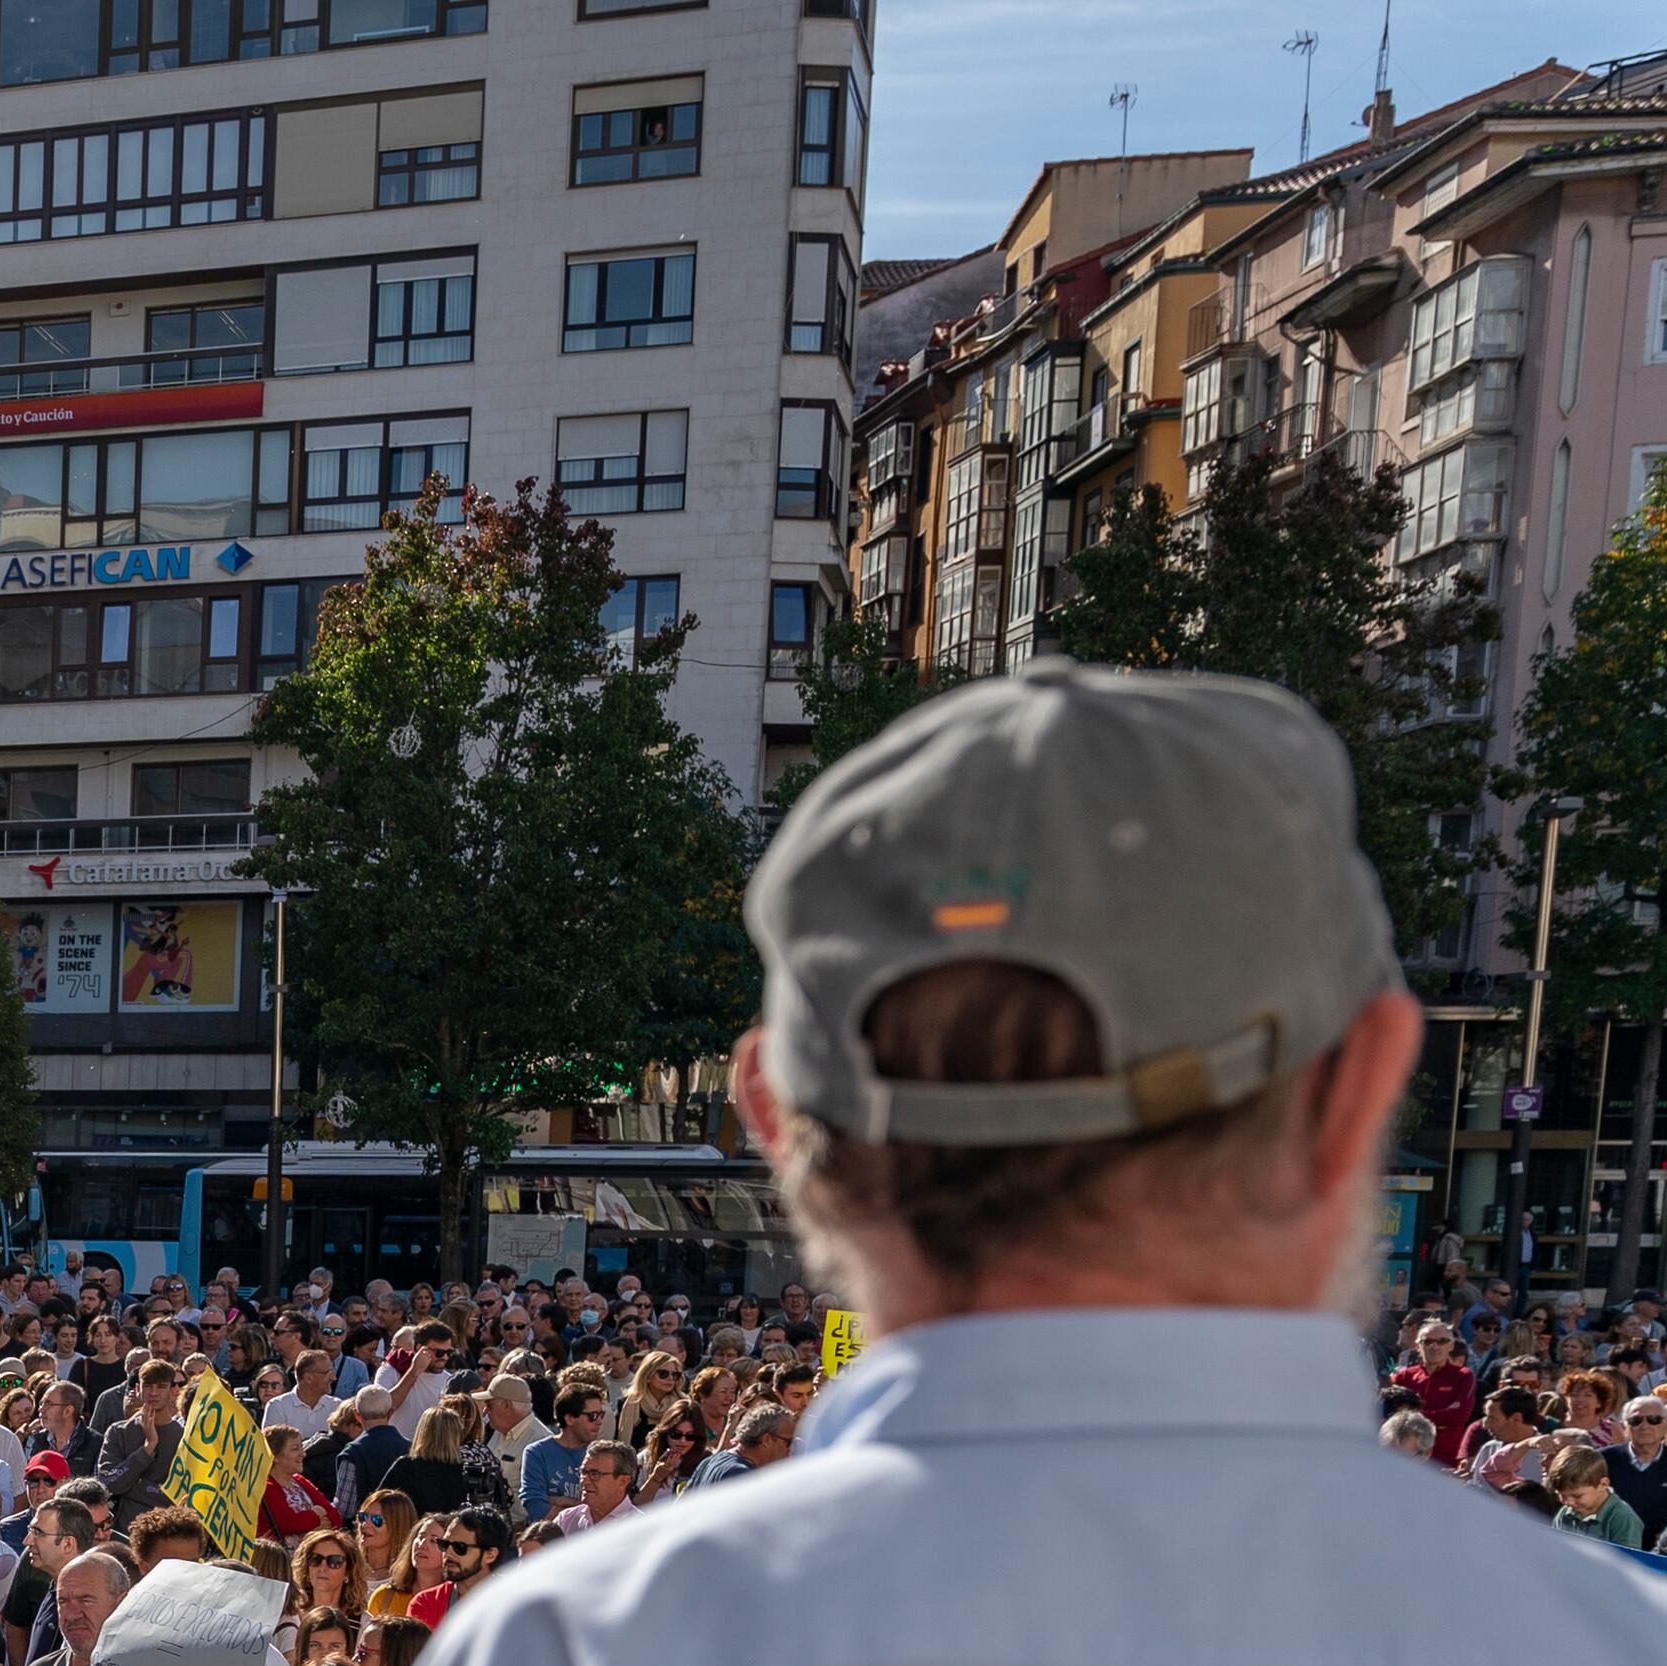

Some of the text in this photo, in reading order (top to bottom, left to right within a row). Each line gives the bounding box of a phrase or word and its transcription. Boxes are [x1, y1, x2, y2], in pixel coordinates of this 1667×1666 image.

[14, 413, 22, 426] y
[23, 407, 74, 424] Caución
[0, 546, 191, 590] ASEFICAN
[67, 861, 186, 885] Catalana
[57, 948, 96, 959] SCENE
[58, 934, 102, 945] ON THE
[57, 961, 92, 972] SINCE
[190, 1393, 264, 1498] 10 MIN
[208, 1456, 237, 1499] POR
[166, 1455, 255, 1562] PACIENTE
[172, 1602, 273, 1656] EXPLOTADOS
